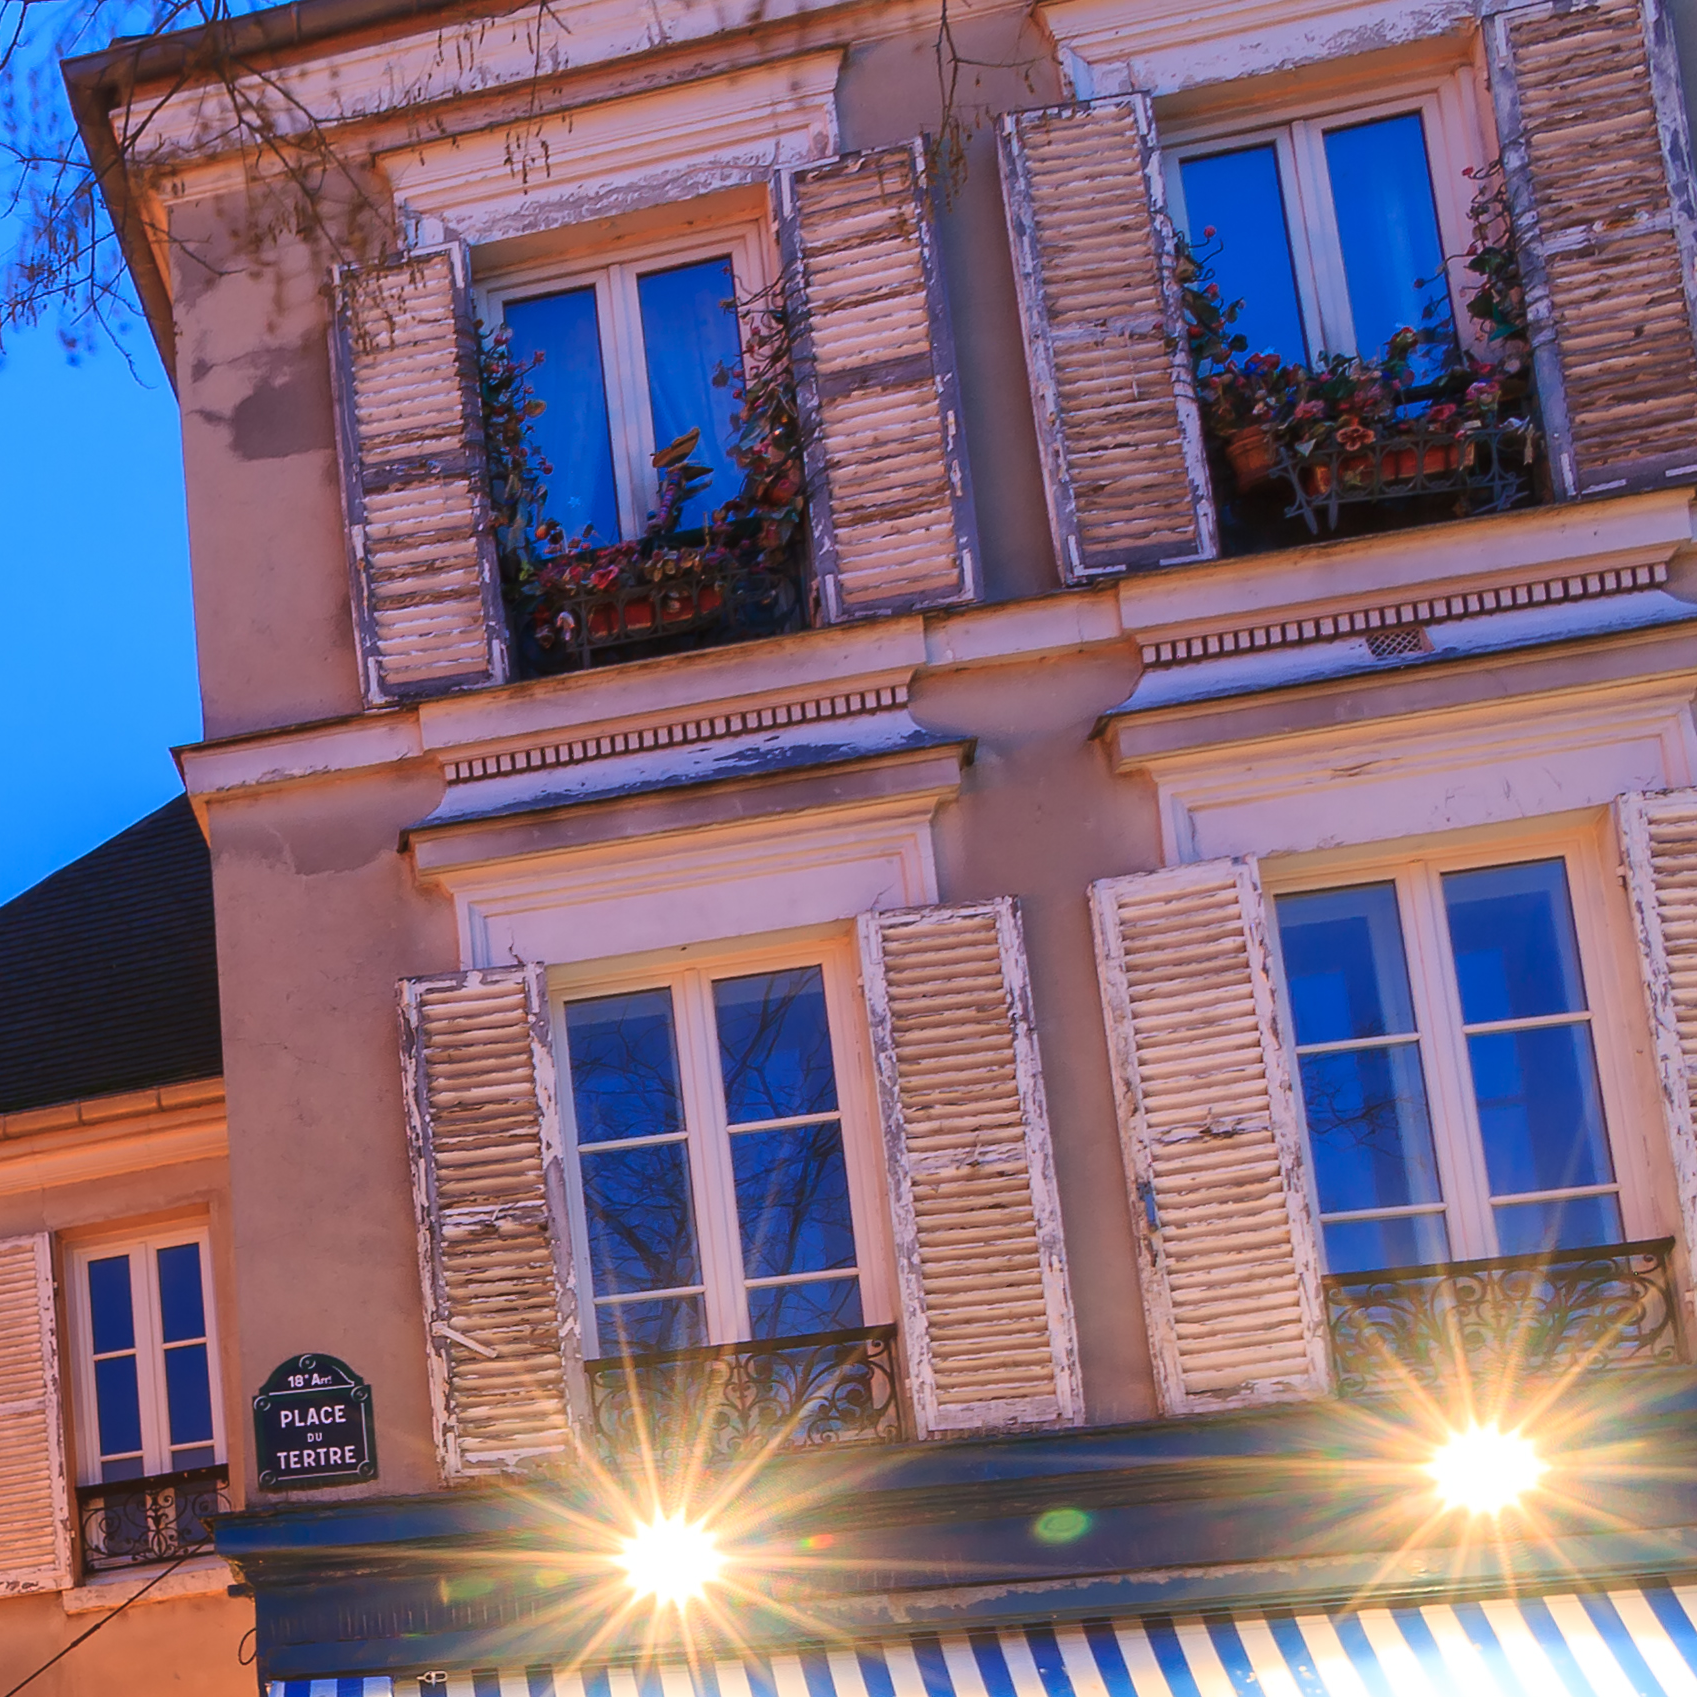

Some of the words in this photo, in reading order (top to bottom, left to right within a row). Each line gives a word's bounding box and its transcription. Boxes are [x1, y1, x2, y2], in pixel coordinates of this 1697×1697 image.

[280, 1405, 347, 1429] PLACE
[307, 1432, 323, 1443] DU
[276, 1445, 357, 1470] TERTRE
